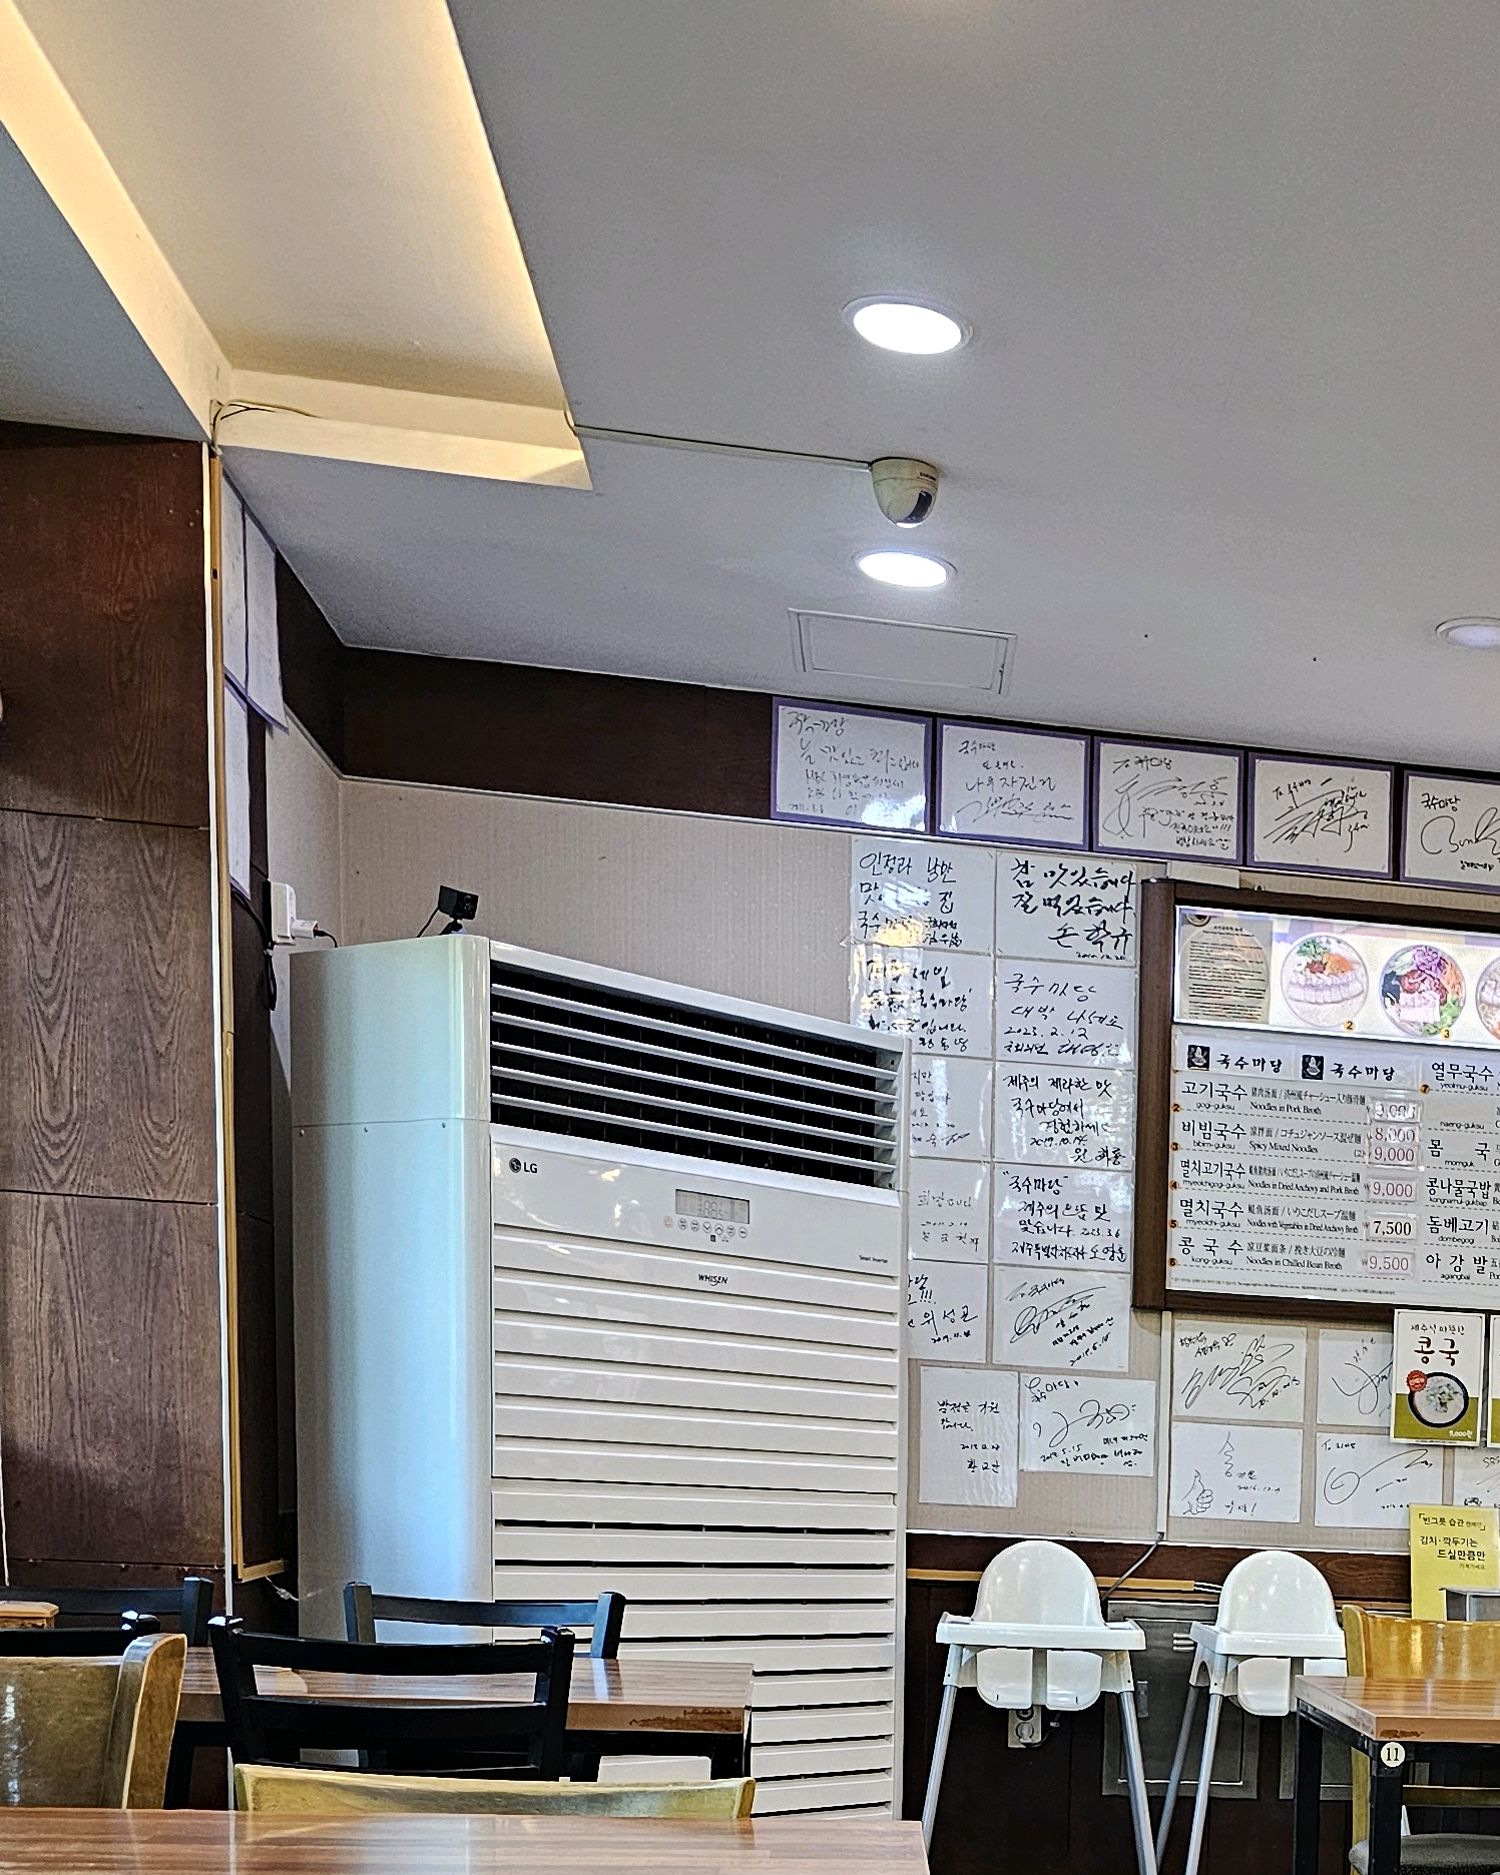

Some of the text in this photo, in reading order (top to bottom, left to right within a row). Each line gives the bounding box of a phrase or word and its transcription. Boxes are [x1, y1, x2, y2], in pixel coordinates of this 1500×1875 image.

[1216, 1053, 1282, 1073] 국수마당
[1330, 1062, 1395, 1082] 국수마당
[1432, 1062, 1494, 1083] 열무국수
[1182, 1081, 1248, 1101] 고기국수
[1182, 1120, 1246, 1141] 비빔국수
[1375, 1147, 1414, 1161] 9,000
[524, 1162, 538, 1174] LG
[1180, 1159, 1246, 1180] 멸치고기국수
[1426, 1177, 1491, 1199] 콩나물국밥
[1179, 1198, 1244, 1219] 멸치국수
[1426, 1216, 1489, 1235] 돔베고기
[698, 1274, 728, 1286] WHISEN
[1414, 1336, 1459, 1366] 콩국
[1450, 1518, 1464, 1528] 습관
[1387, 1748, 1399, 1761] 11
